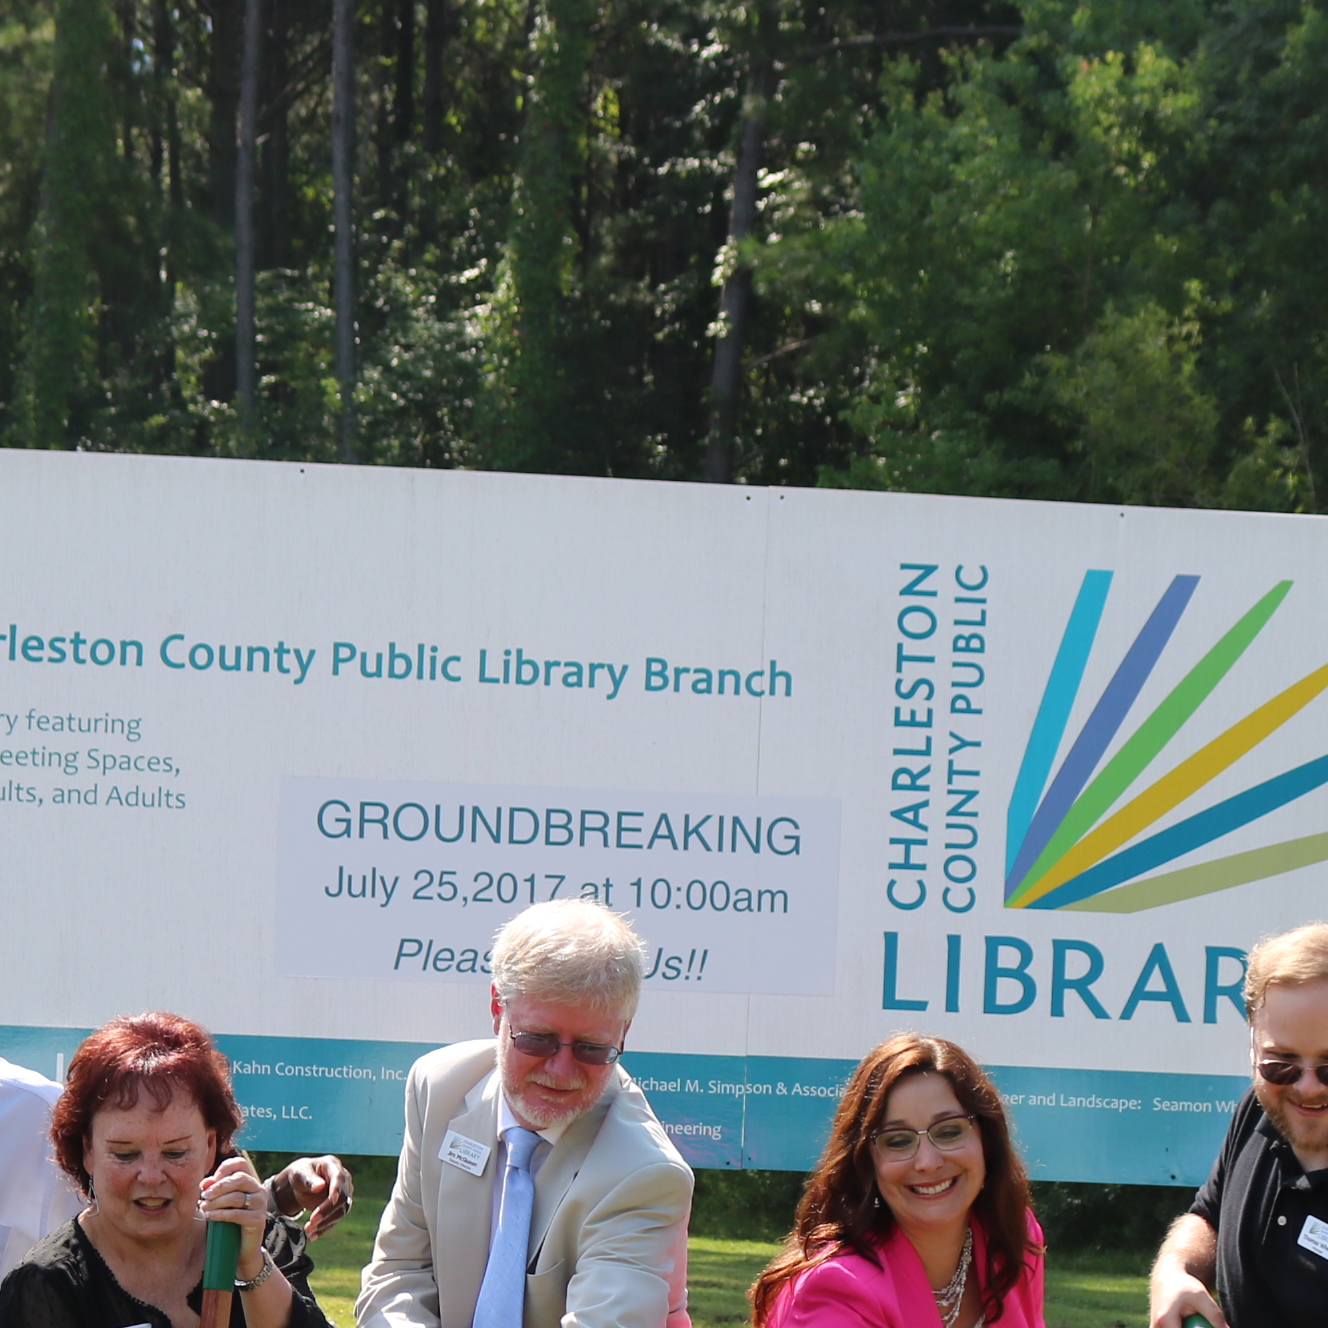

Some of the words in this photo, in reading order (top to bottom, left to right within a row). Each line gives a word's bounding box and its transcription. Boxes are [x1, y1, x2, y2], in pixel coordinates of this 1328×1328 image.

[949, 564, 989, 715] PUBLIC
[159, 633, 316, 685] County
[332, 641, 462, 683] Public
[478, 648, 629, 700] Library
[644, 657, 792, 698] Branch
[26, 708, 142, 742] featuring
[886, 563, 939, 911] CHARLESTON
[87, 748, 180, 777] Spaces,
[52, 783, 98, 805] and
[105, 785, 186, 809] Adults
[317, 799, 801, 856] GROUNDBREAKING
[942, 730, 982, 914] COUNTY
[325, 865, 400, 908] July
[412, 869, 566, 907] 25,2017
[579, 877, 613, 906] at
[630, 877, 788, 914] 10:00am
[394, 938, 492, 975] Plea
[882, 931, 1249, 1024] LIBRAR
[233, 1060, 271, 1075] Kahn
[275, 1062, 376, 1081] Construction,
[381, 1066, 407, 1080] Inc.
[685, 1079, 704, 1093] M.
[708, 1080, 772, 1098] Simpson
[776, 1082, 788, 1096] &
[282, 1105, 313, 1120] LLC.
[1028, 1092, 1056, 1106] and
[1060, 1094, 1142, 1112] Landscape:
[1153, 1097, 1212, 1113] Seamon
